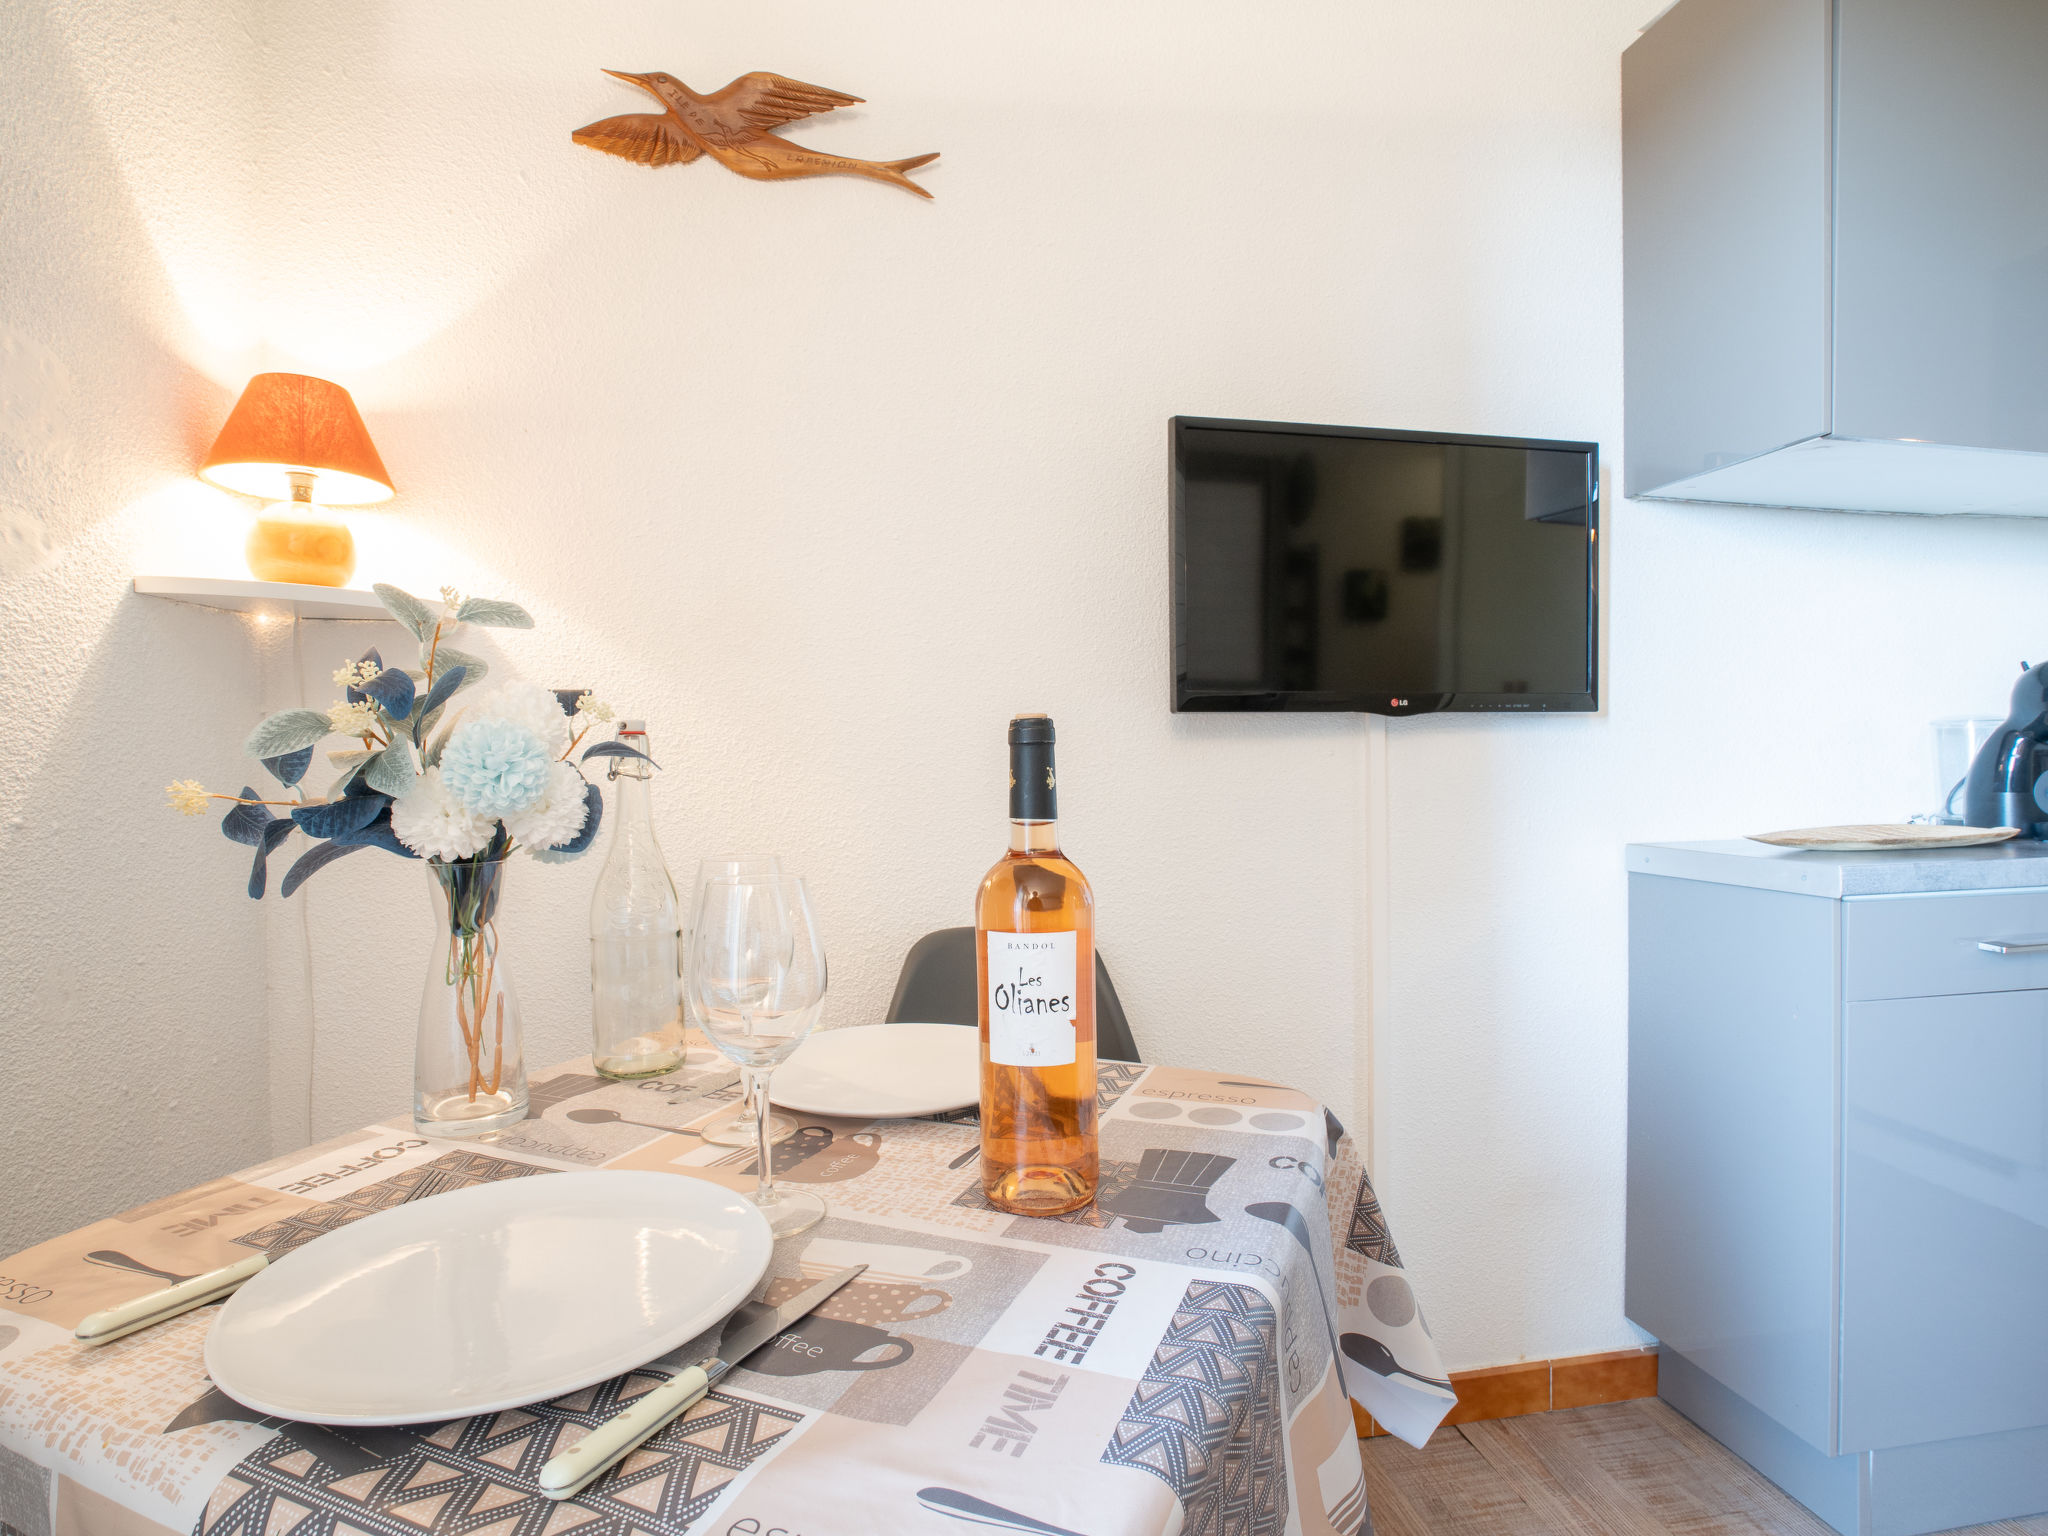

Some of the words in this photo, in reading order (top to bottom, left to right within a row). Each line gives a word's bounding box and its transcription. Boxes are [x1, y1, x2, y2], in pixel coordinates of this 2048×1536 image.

[1007, 942, 1056, 950] BANDOL
[1018, 967, 1042, 987] Les
[995, 983, 1070, 1015] Olianes
[637, 1080, 744, 1102] COFEE
[1142, 1088, 1256, 1104] espresso
[278, 1139, 429, 1194] COFFEE
[820, 1153, 860, 1177] coffee
[160, 1197, 281, 1237] TIME
[1034, 1262, 1136, 1365] COFFEE
[968, 1370, 1070, 1458] TIME
